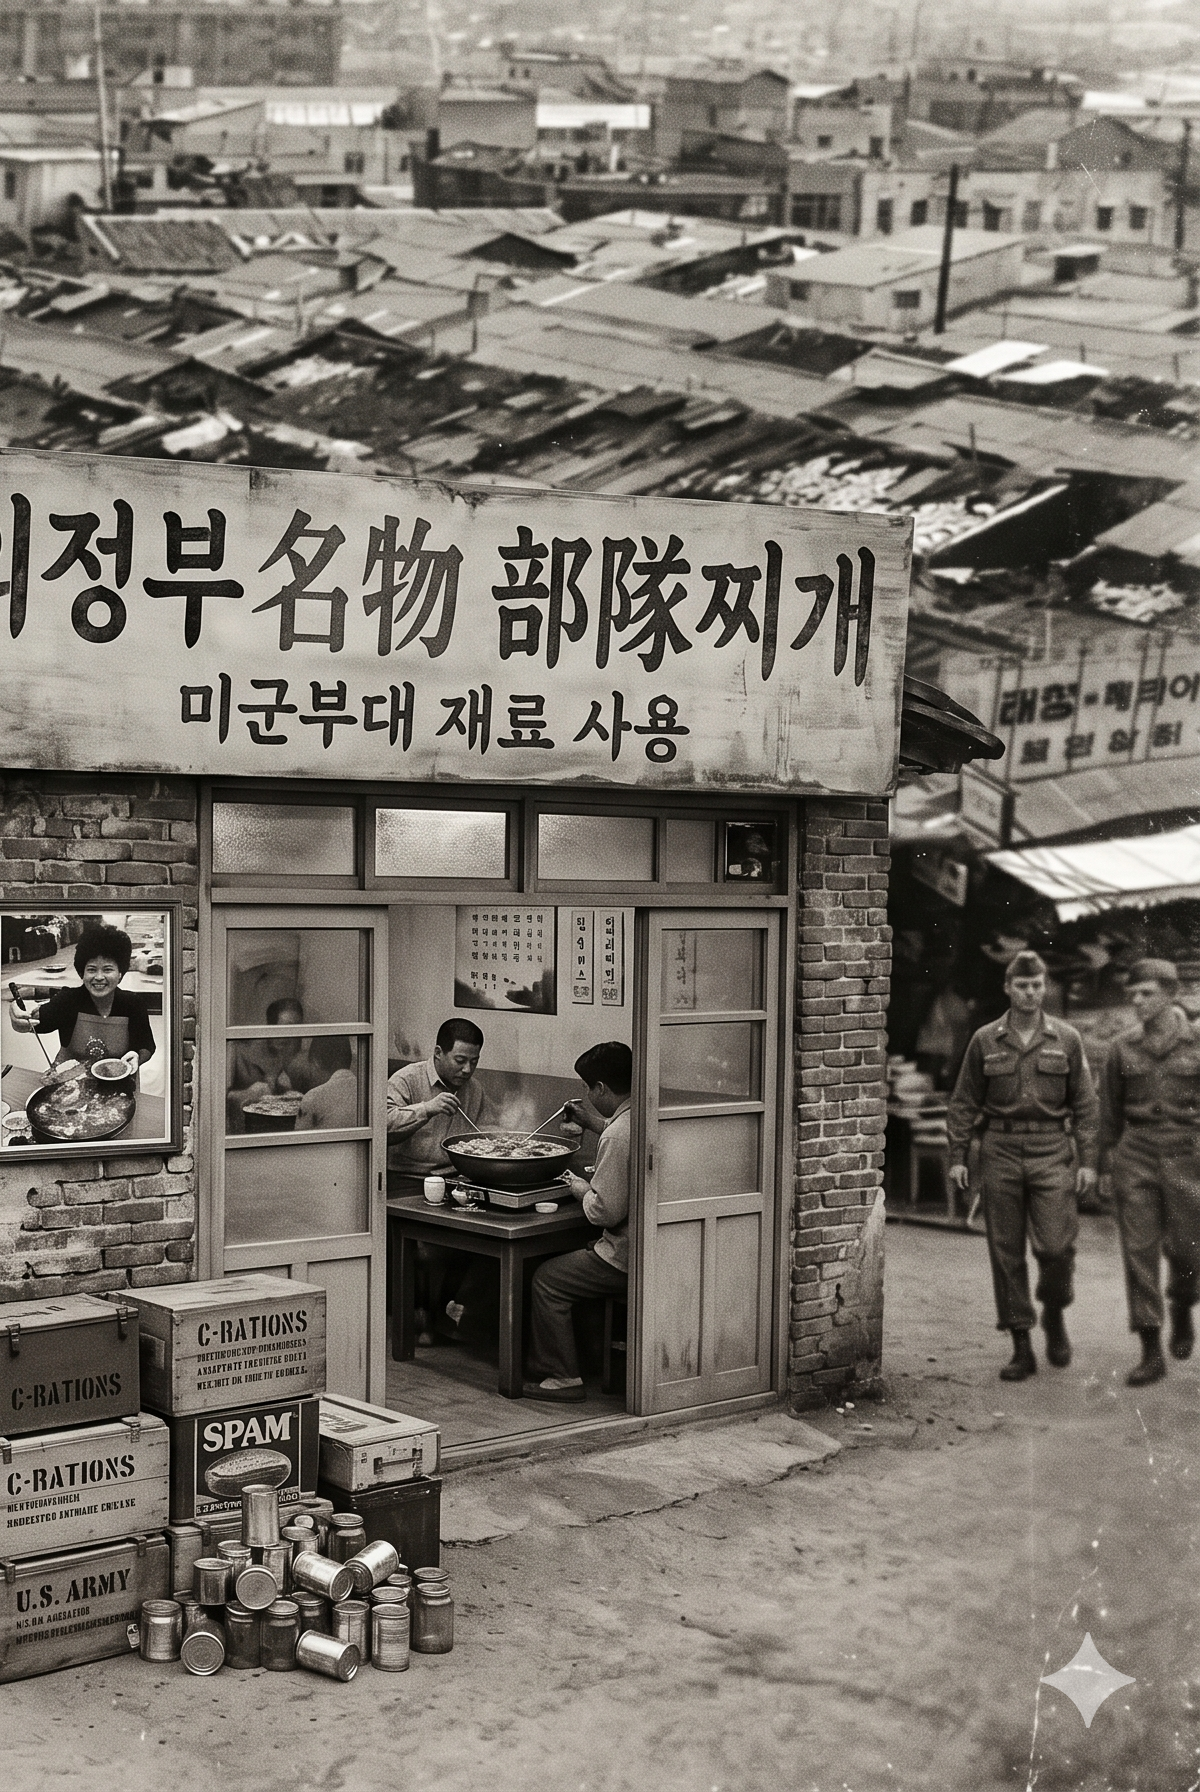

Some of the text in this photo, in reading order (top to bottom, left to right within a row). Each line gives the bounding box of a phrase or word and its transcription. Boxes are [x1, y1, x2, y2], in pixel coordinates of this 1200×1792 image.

[179, 671, 692, 764] 미군부대 재료 사용
[197, 1309, 309, 1348] C-RATIONS
[10, 1372, 122, 1412] C-RATIONS
[202, 1411, 293, 1453] SPAM
[7, 1454, 136, 1496] C-RATIONS
[16, 1568, 131, 1613] U.S. ARMY
